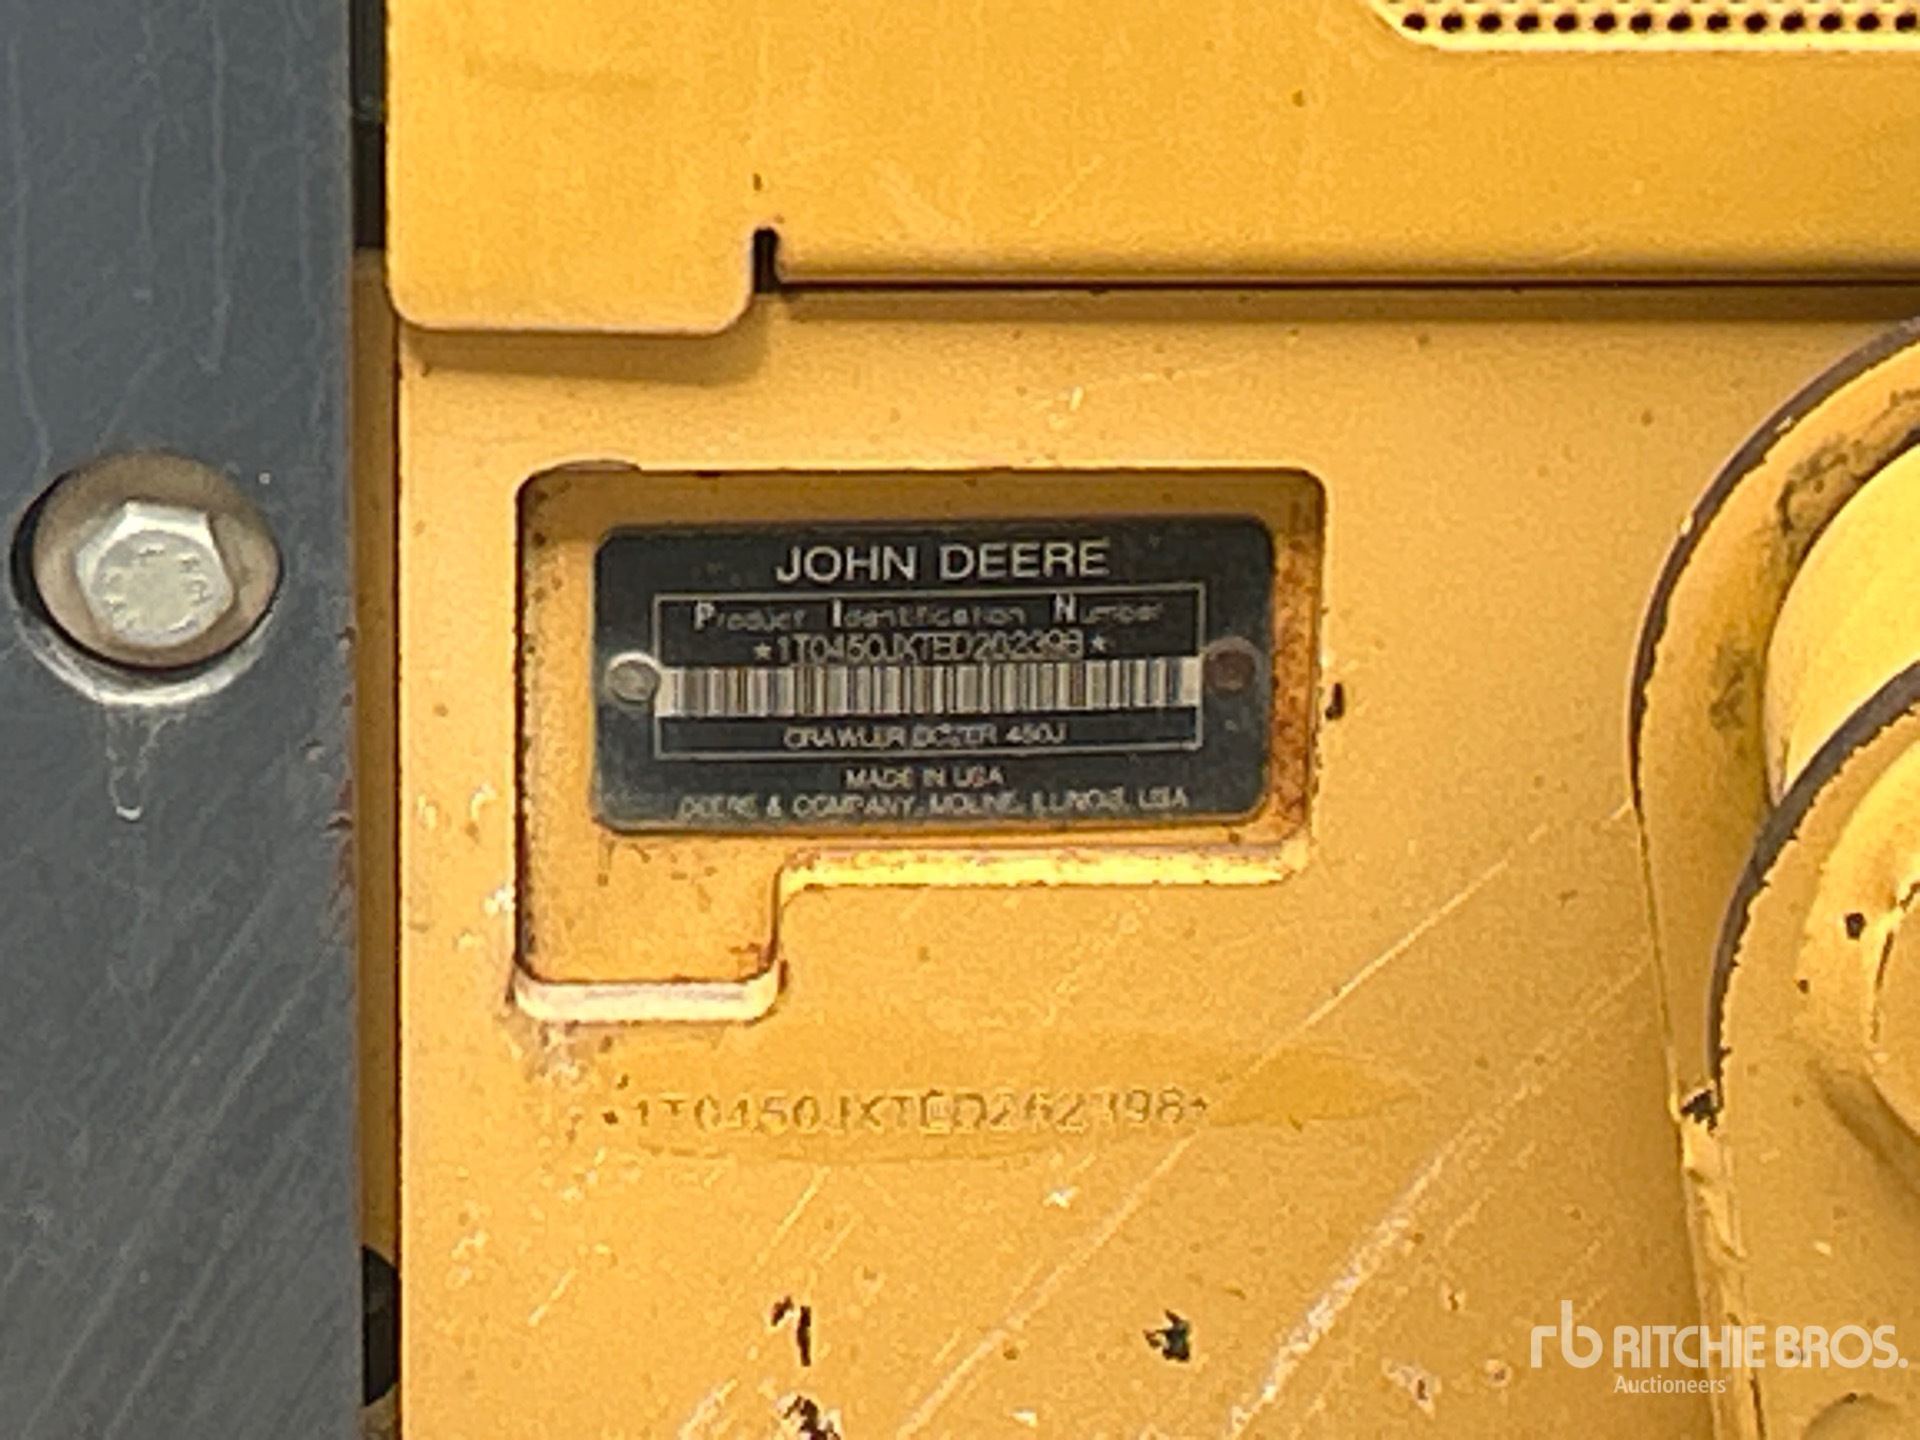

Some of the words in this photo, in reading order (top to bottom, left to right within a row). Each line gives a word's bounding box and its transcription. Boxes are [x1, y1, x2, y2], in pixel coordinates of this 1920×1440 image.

[776, 545, 917, 584] JOHN
[939, 539, 1110, 579] DEERE
[693, 599, 807, 630] Product
[830, 596, 1026, 628] Identification
[845, 767, 915, 789] MADE
[922, 766, 949, 788] IN
[954, 765, 1005, 787] USA
[766, 796, 781, 818] &
